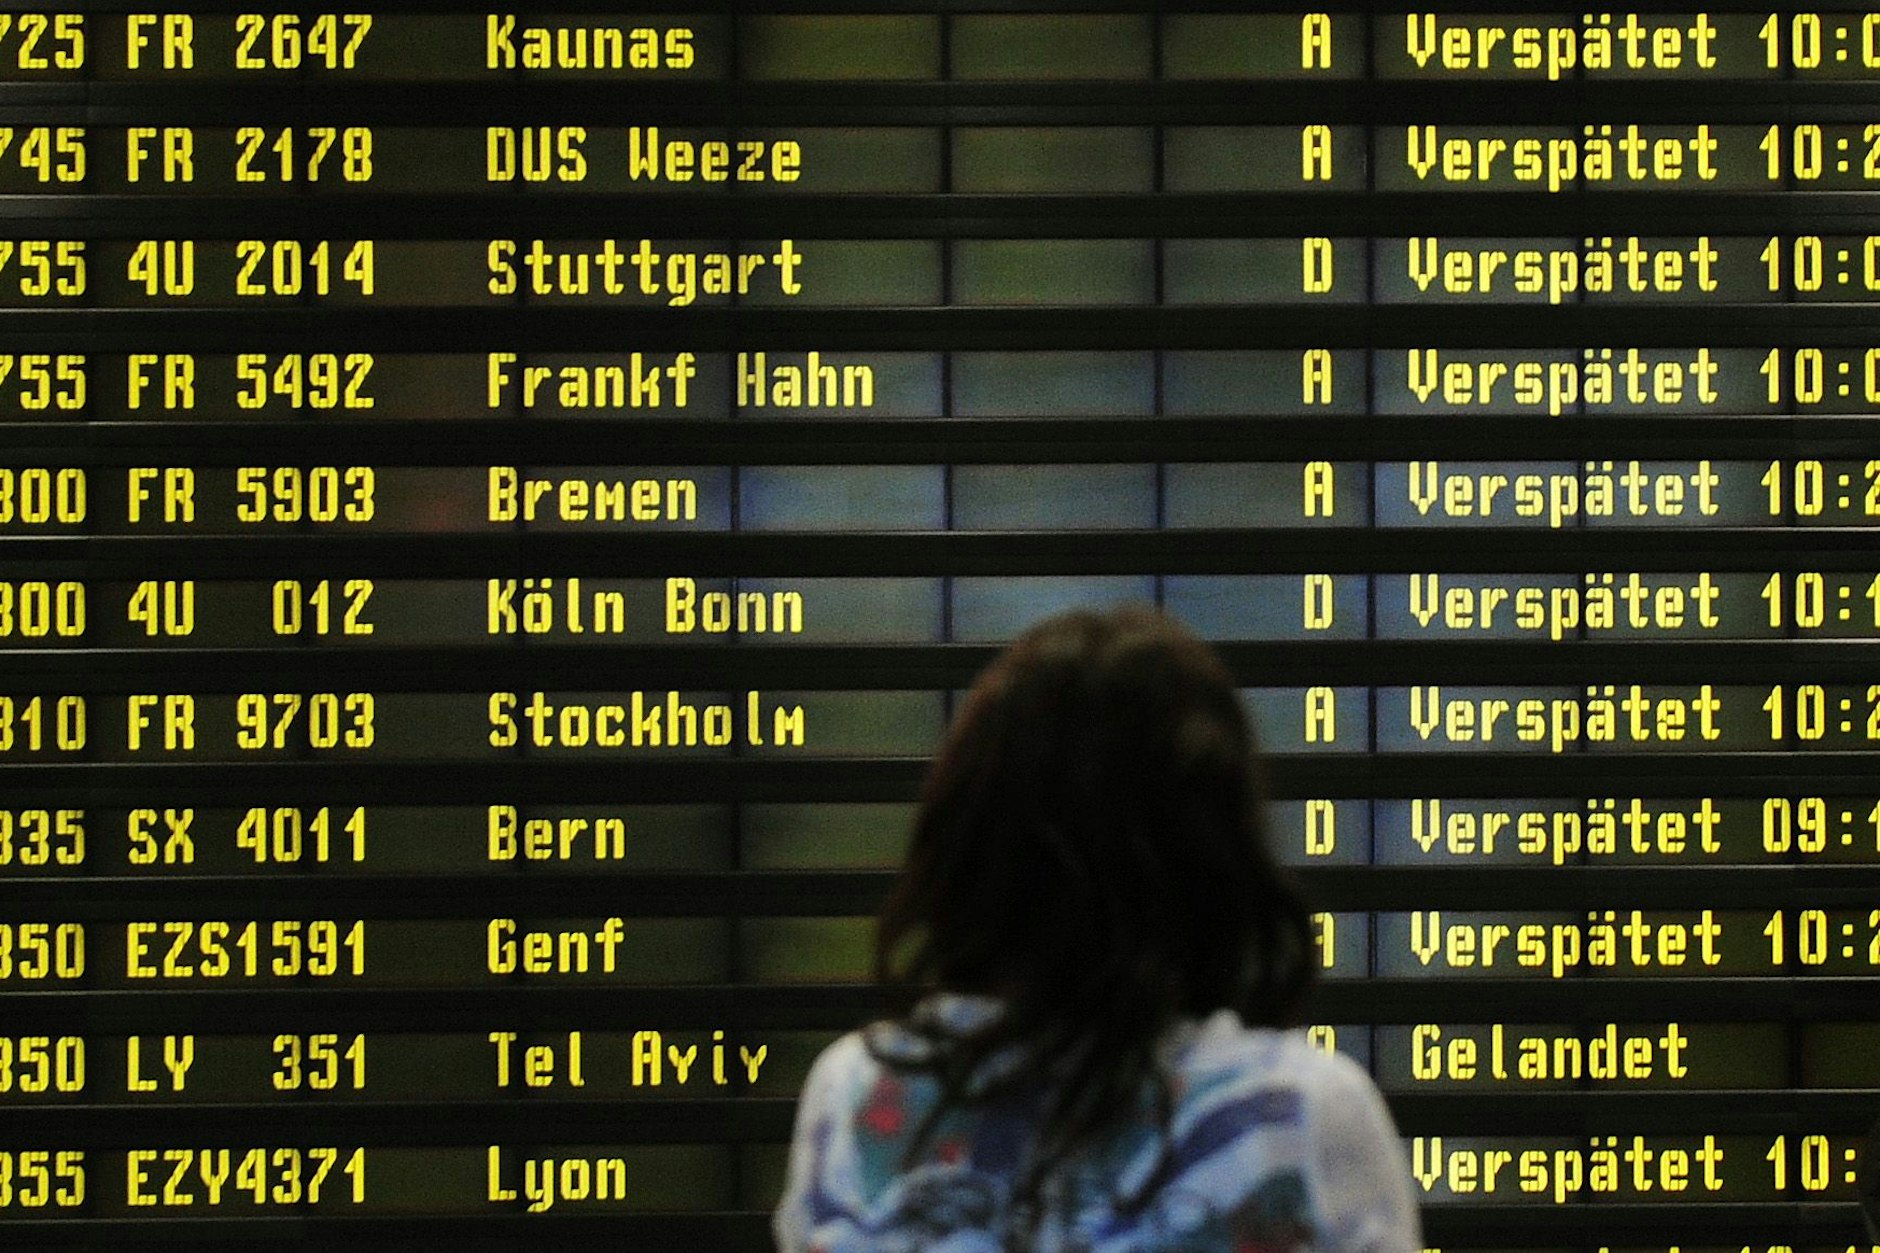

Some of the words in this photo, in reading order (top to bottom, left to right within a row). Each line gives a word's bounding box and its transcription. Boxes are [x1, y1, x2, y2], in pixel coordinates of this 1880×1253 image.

[127, 14, 194, 69] FR
[235, 14, 373, 69] 2647
[486, 14, 695, 69] Kaunas
[1301, 13, 1332, 69] A
[1406, 13, 1718, 81] Verspätet
[127, 127, 194, 182] FR
[235, 127, 373, 182] 2178
[486, 126, 588, 182] DUS
[628, 126, 802, 182] Weeze
[1302, 125, 1332, 181] A
[1407, 124, 1719, 193] Verspätet
[127, 240, 194, 296] 4U
[235, 240, 375, 296] 2014
[487, 239, 803, 307] Stuttgart
[1302, 237, 1333, 293] D
[1408, 236, 1719, 305] Verspätet
[128, 354, 195, 409] FR
[236, 353, 375, 409] 5492
[488, 352, 697, 408] Frankf
[737, 351, 874, 407] Hahn
[1303, 349, 1333, 404] A
[1408, 348, 1719, 416] Verspätet
[128, 467, 195, 523] FR
[236, 466, 375, 522] 5903
[488, 466, 697, 522] Bremen
[1303, 461, 1334, 517] A
[1408, 460, 1720, 528] Verspätet
[127, 580, 195, 636] 4U
[272, 579, 375, 635] 012
[488, 578, 625, 634] Köln
[665, 577, 804, 633] Bonn
[1304, 574, 1334, 630] D
[1409, 572, 1720, 641] Verspätet
[127, 694, 195, 750] FR
[236, 693, 375, 749] 9703
[488, 690, 805, 748] Stockholm
[1304, 686, 1335, 743] A
[1410, 684, 1721, 753] Verspätet
[127, 808, 194, 864] SX
[236, 806, 366, 862] 4011
[487, 805, 626, 861] Bern
[1304, 799, 1335, 856] D
[1410, 798, 1721, 865] Verspätet
[126, 919, 365, 978] EZS1591
[487, 917, 625, 974] Genf
[1410, 910, 1722, 978] Verspätet
[127, 1035, 195, 1091] LY
[272, 1034, 366, 1090] 351
[488, 1031, 586, 1087] Tel
[631, 1030, 768, 1086] Aviv
[1412, 1023, 1689, 1080] Gelandet
[127, 1147, 366, 1206] EZY4371
[487, 1145, 627, 1213] Lyon
[1412, 1135, 1724, 1204] Verspätet
